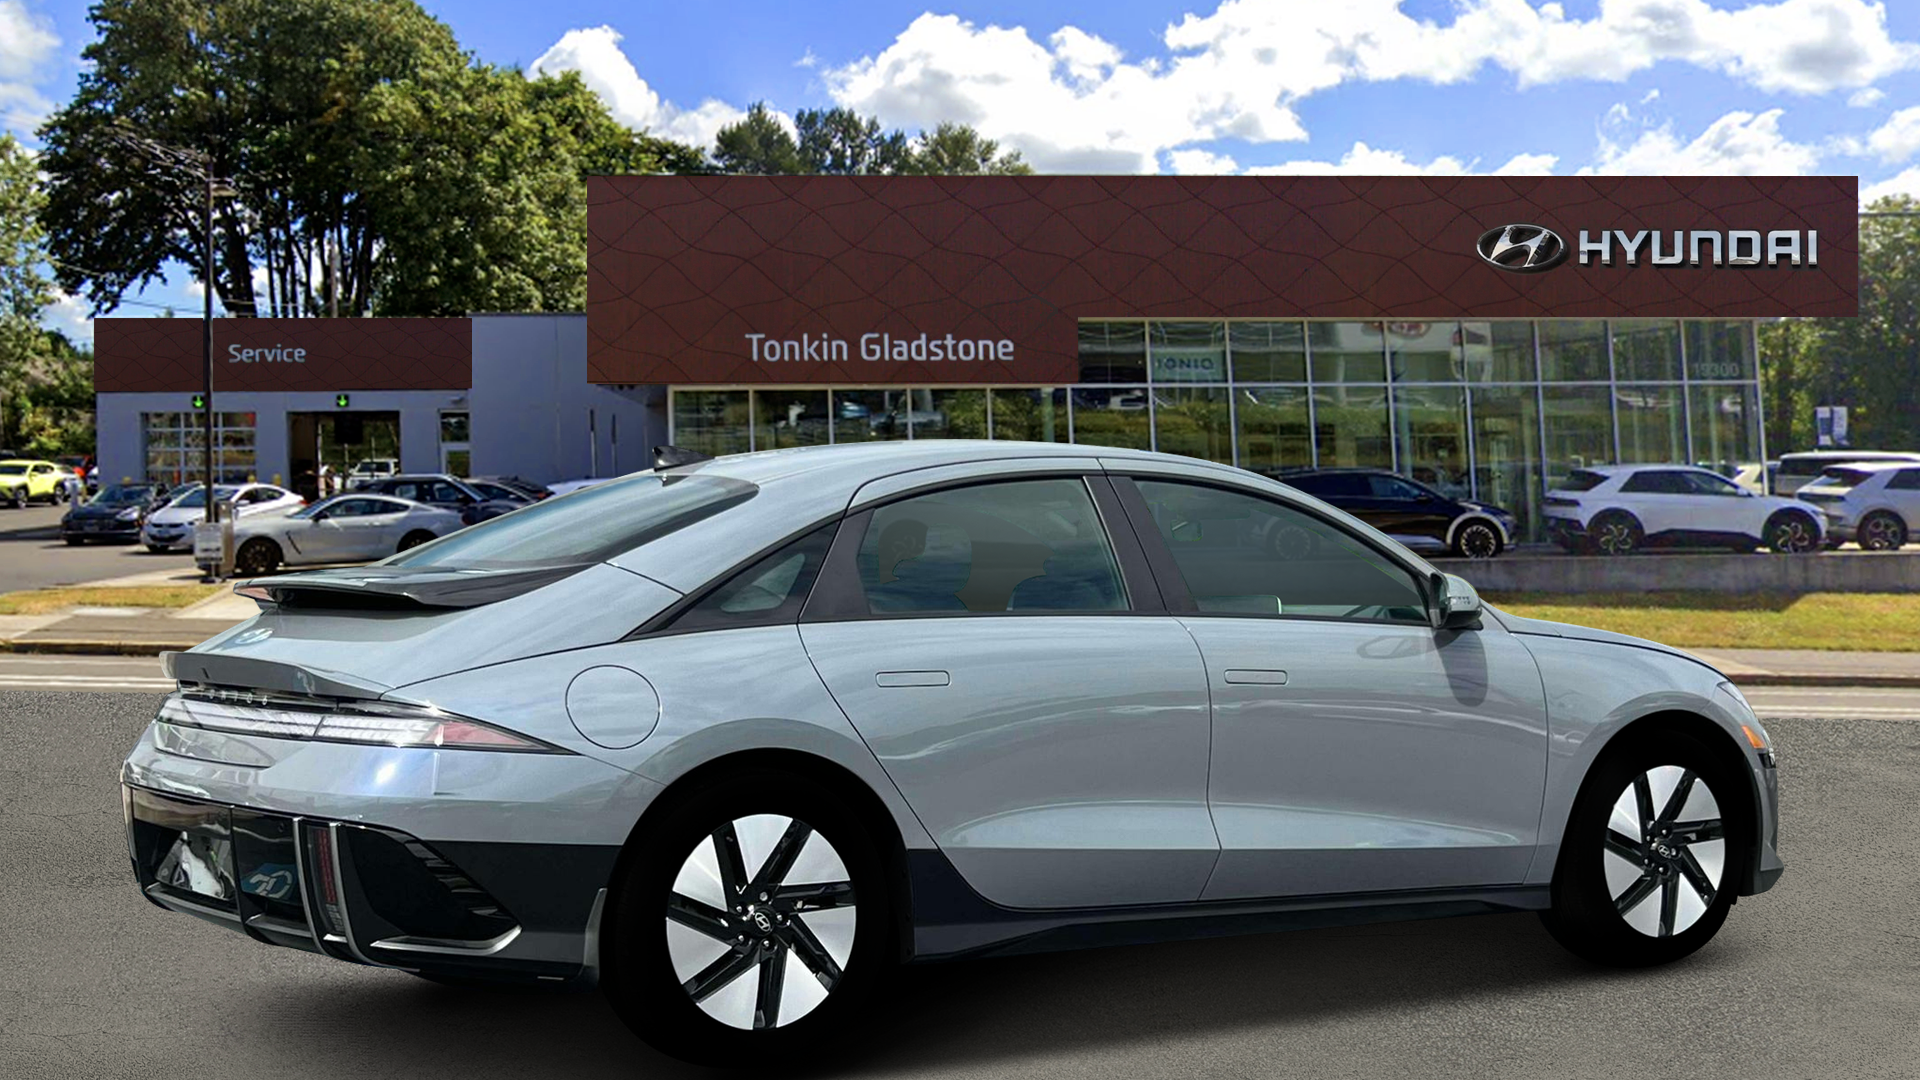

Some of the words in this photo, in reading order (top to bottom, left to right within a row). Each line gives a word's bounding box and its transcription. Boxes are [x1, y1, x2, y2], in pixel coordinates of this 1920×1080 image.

[1578, 230, 1818, 265] HYUNDAI
[227, 343, 307, 363] Service
[744, 332, 849, 362] Tonkin
[859, 332, 1015, 362] Gladstone
